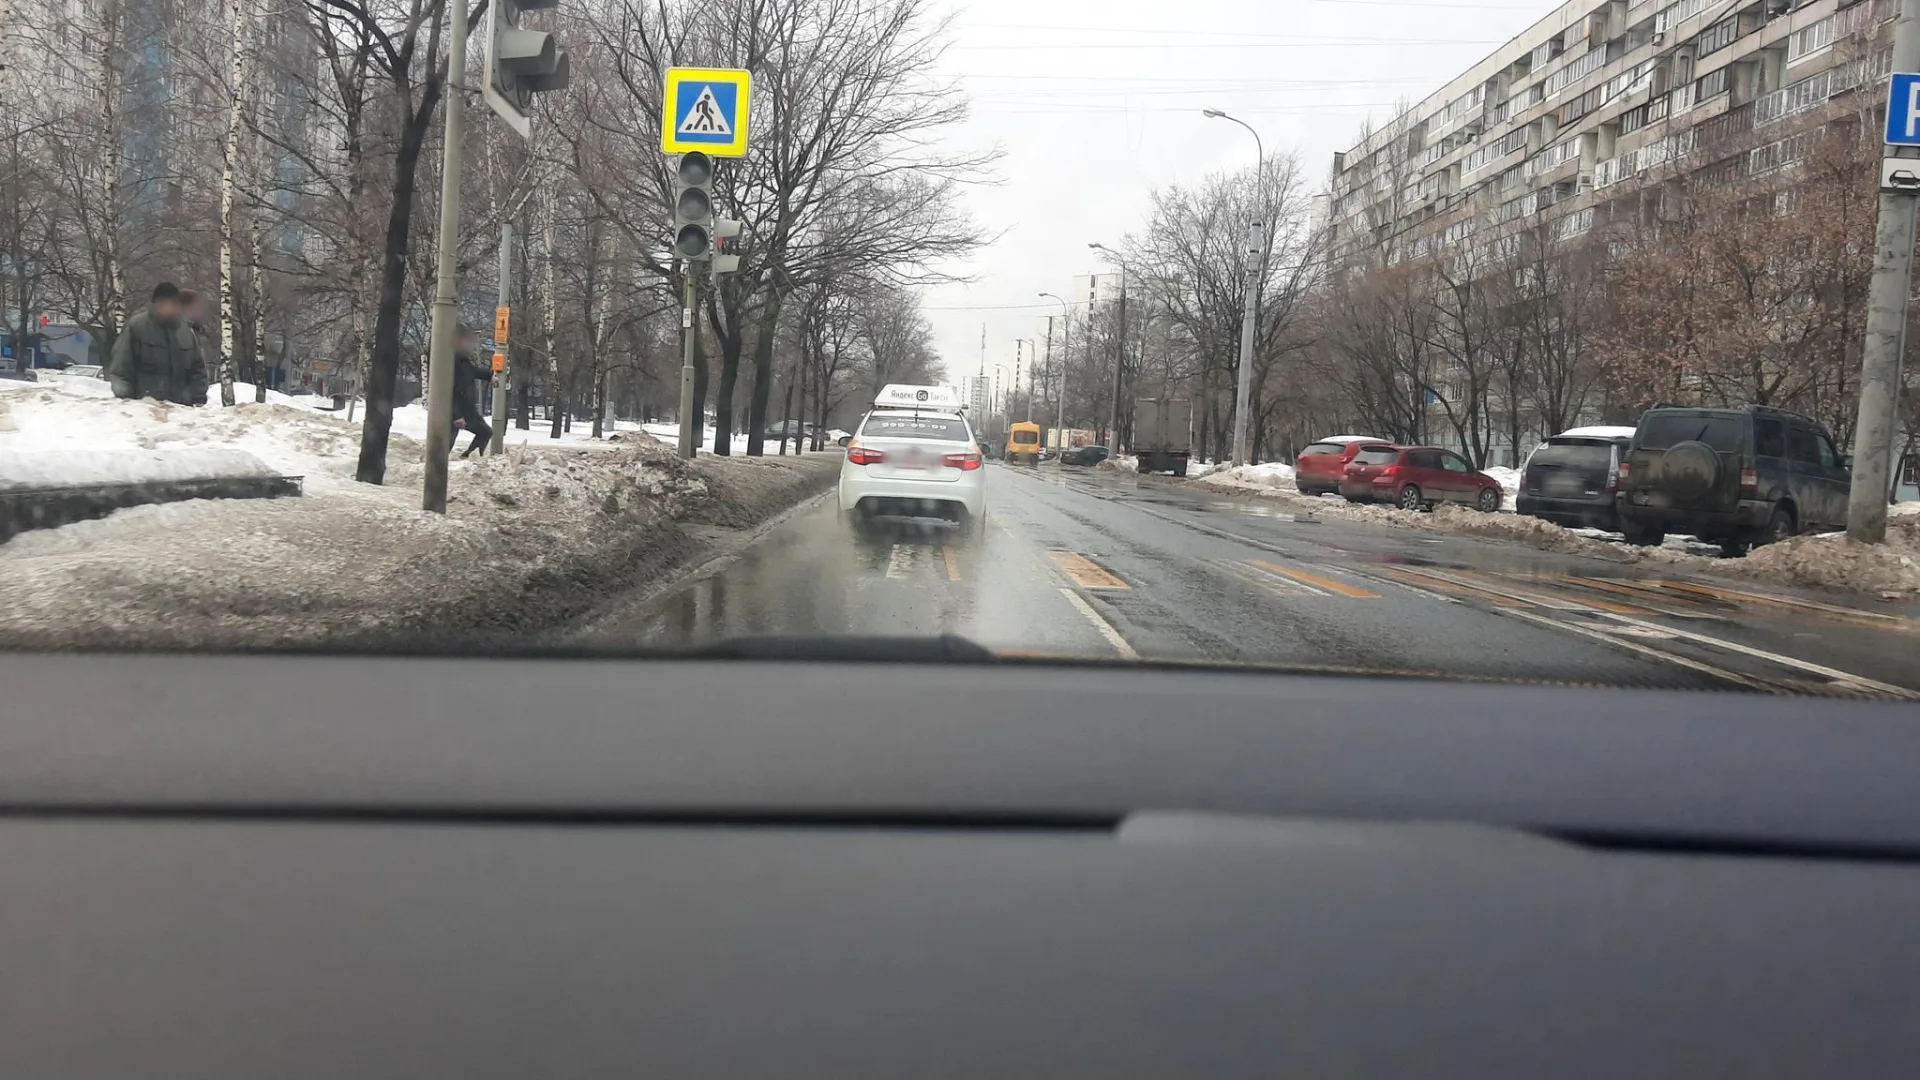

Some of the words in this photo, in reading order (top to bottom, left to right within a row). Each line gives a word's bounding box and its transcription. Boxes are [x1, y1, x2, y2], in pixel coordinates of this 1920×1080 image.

[891, 390, 914, 400] Яндекс
[917, 391, 927, 400] Go
[930, 392, 948, 401] Такси
